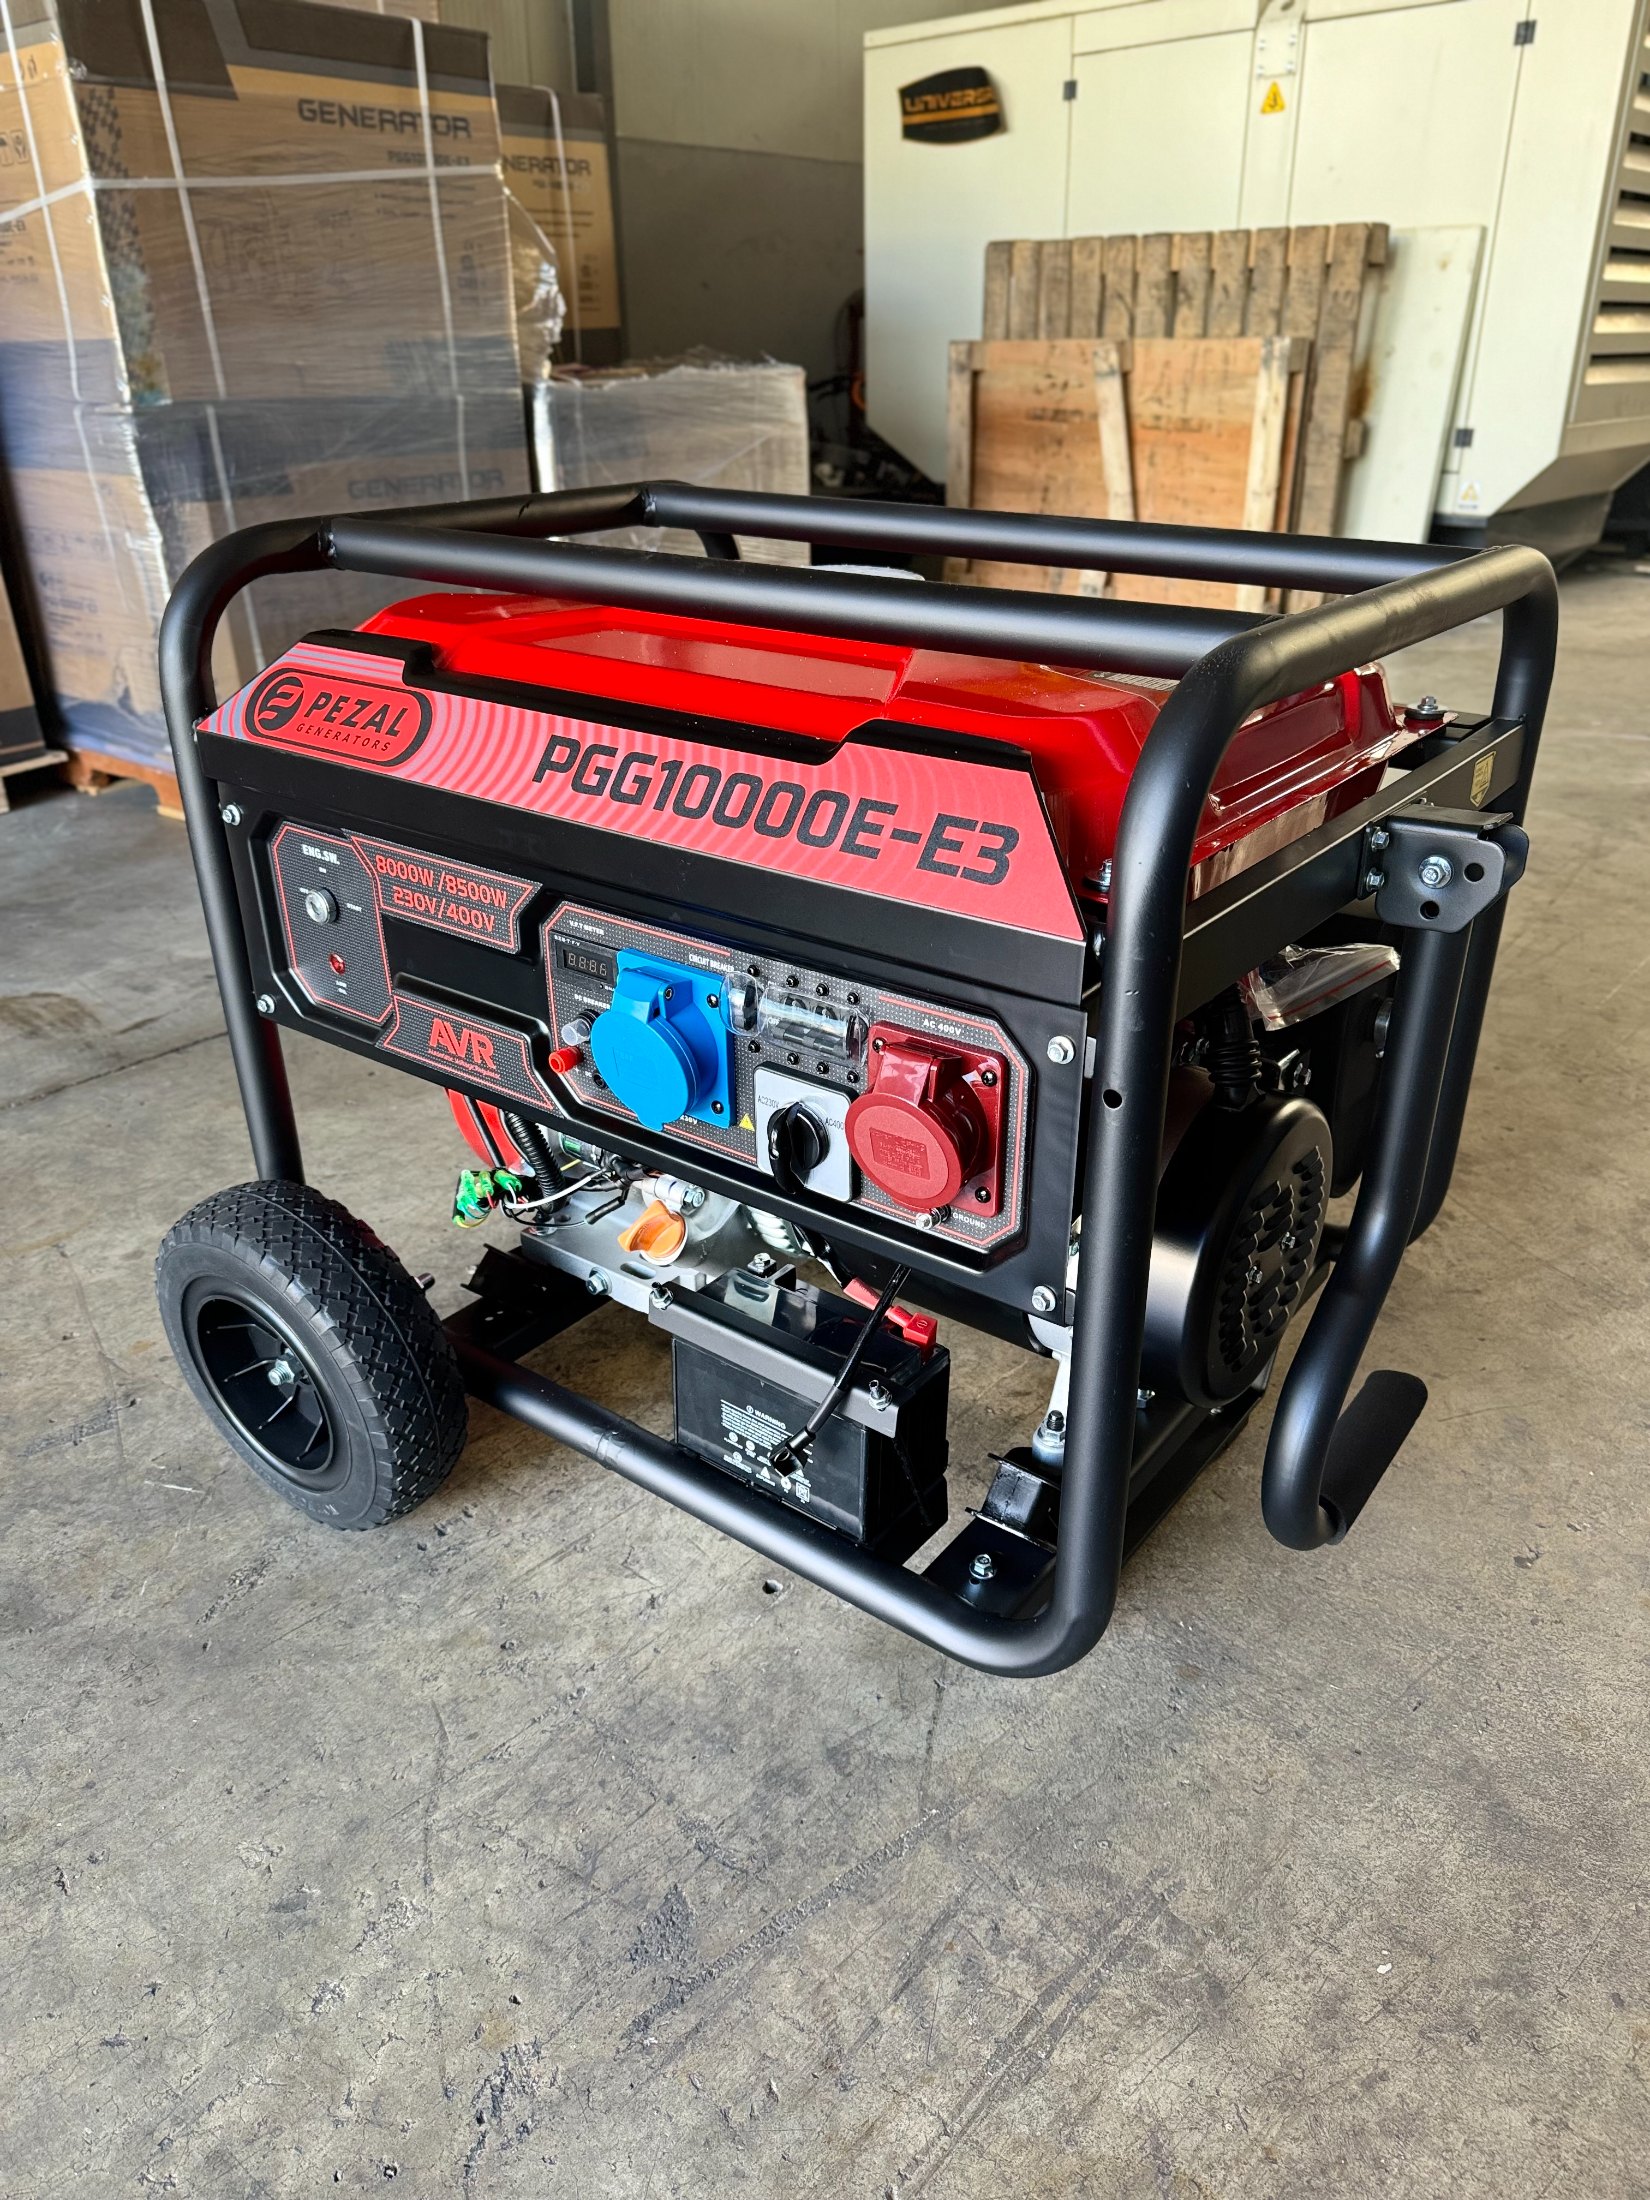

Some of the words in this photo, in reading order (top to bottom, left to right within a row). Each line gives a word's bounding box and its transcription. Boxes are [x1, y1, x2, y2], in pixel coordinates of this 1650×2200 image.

[303, 691, 408, 737] PEZAL
[296, 723, 391, 752] GENERATORS
[532, 734, 1020, 886] PGG10000E-E3
[429, 1017, 496, 1069] AVR
[923, 1019, 936, 1028] AC
[938, 1023, 961, 1036] 400V
[952, 1212, 986, 1229] GROUND
